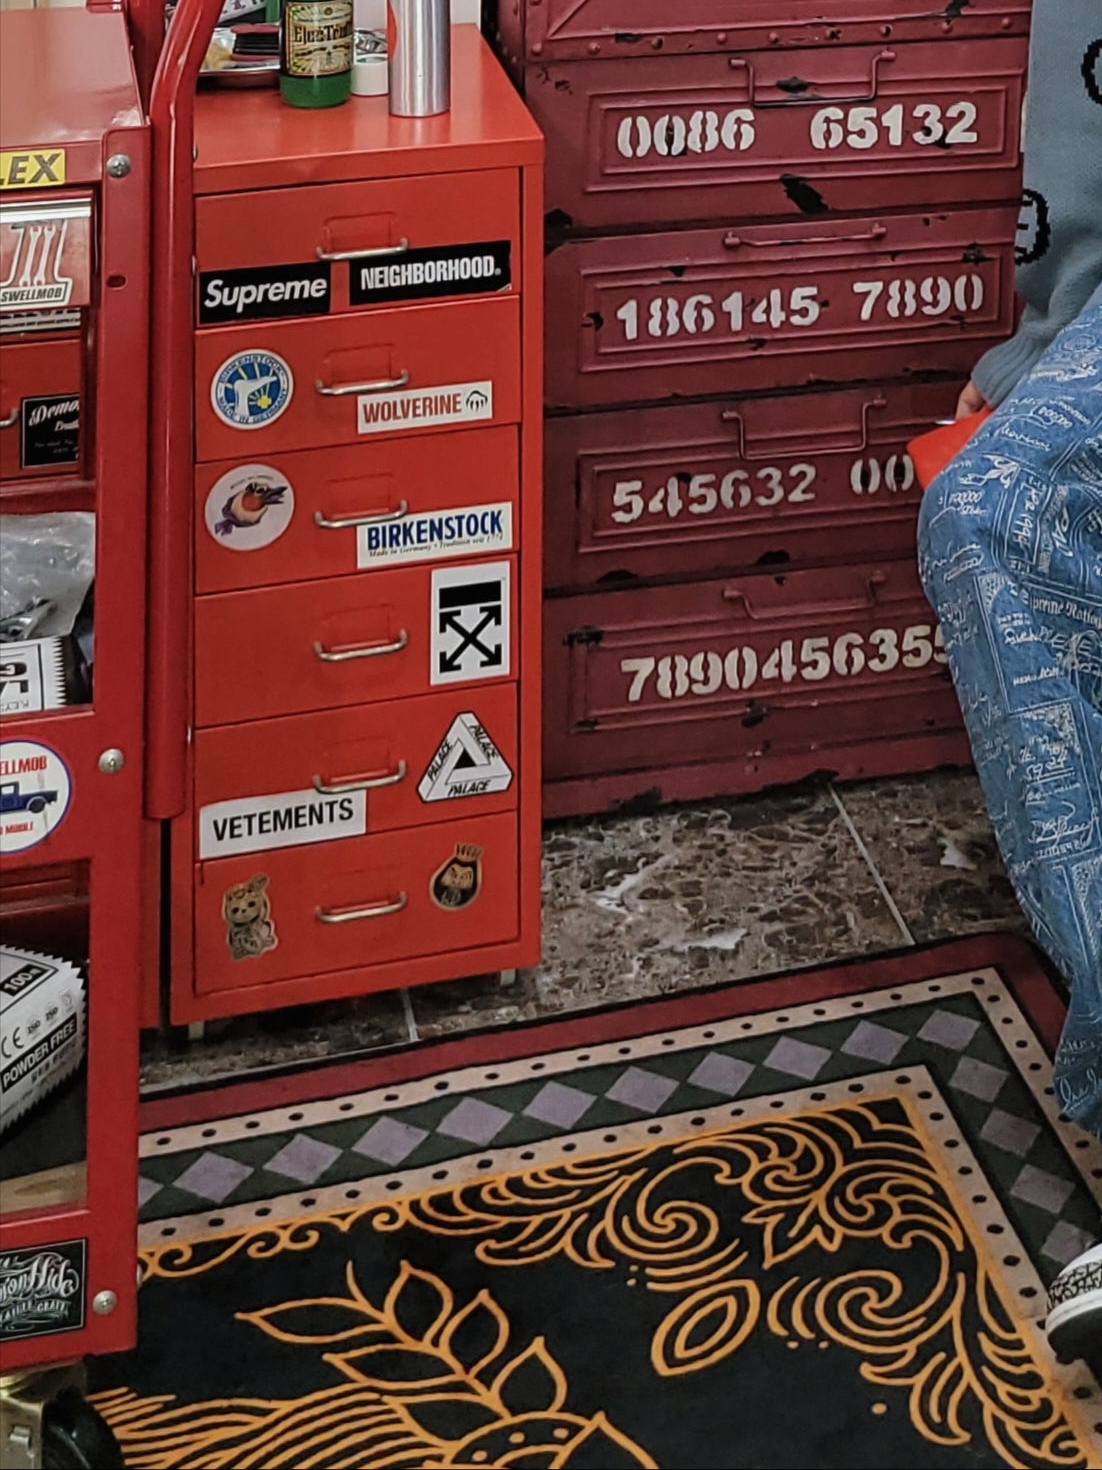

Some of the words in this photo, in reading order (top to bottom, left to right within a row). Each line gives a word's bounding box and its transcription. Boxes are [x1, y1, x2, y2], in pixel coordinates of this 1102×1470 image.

[615, 109, 757, 158] 0086
[809, 101, 979, 150] 65132
[0, 152, 62, 185] EX
[0, 286, 62, 304] SWELLMOB
[203, 276, 328, 313] Supreme
[616, 285, 820, 341] 186145
[852, 272, 984, 323] 7890
[362, 393, 462, 425] WOLVERINE
[611, 463, 817, 524] 545632
[367, 509, 503, 551] BIRKENSTOCK
[427, 738, 453, 783] PALACE
[469, 724, 500, 759] PALACE
[447, 778, 491, 797] PALACE
[212, 797, 354, 842] VETEMENTS
[2, 1043, 49, 1089] POWDER
[50, 1020, 76, 1051] FREE
